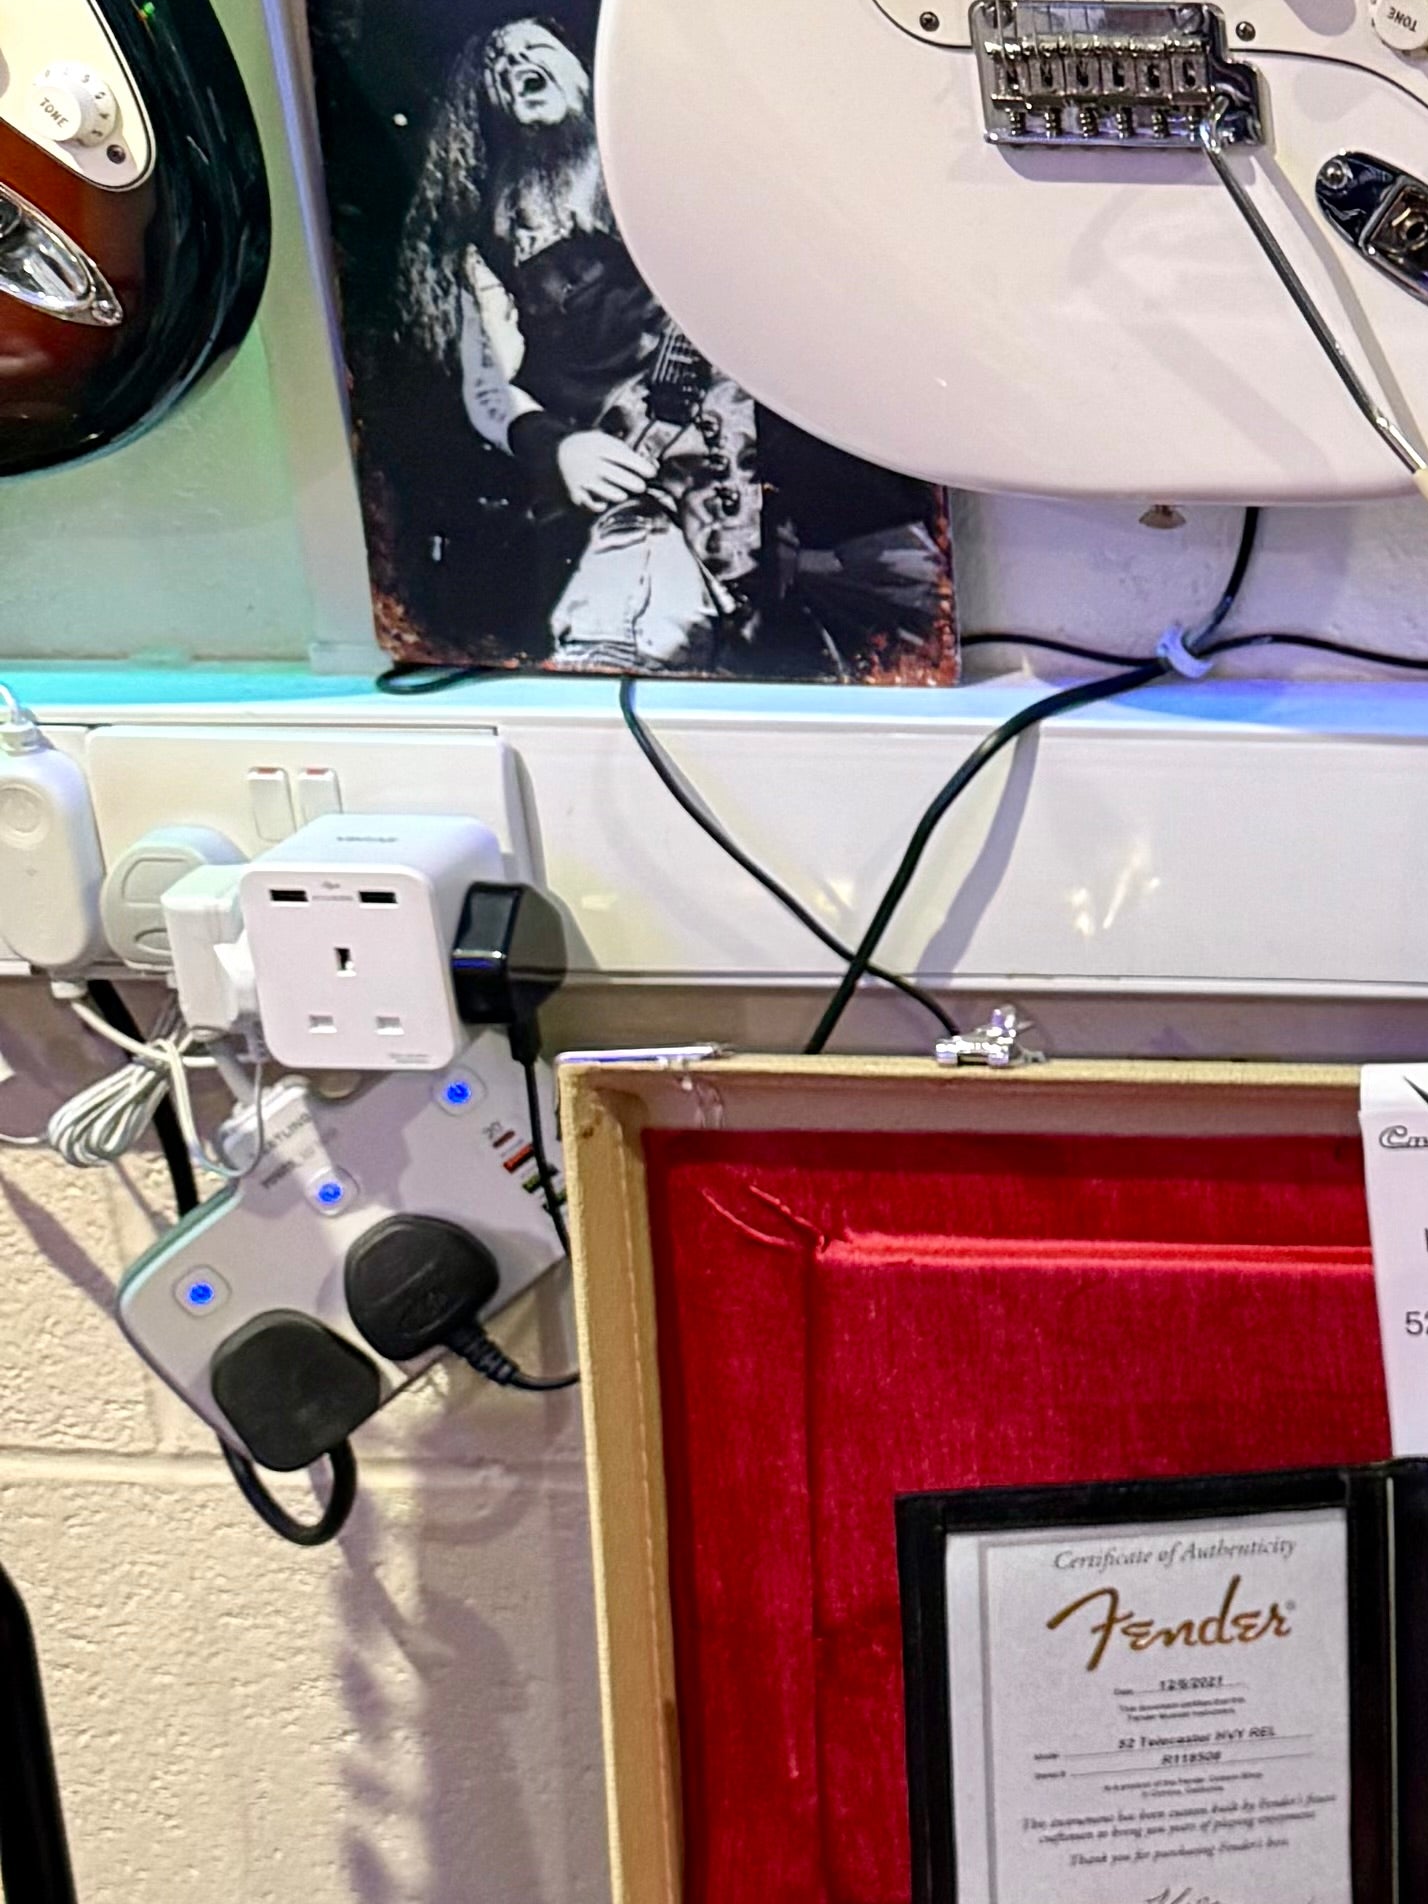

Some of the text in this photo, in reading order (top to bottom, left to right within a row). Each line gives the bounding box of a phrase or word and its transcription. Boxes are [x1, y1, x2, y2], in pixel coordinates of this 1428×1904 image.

[1386, 5, 1418, 33] TONE
[40, 96, 69, 128] TONE
[1053, 1535, 1297, 1574] Certificate of Authenticity
[1045, 1573, 1292, 1672] Fender
